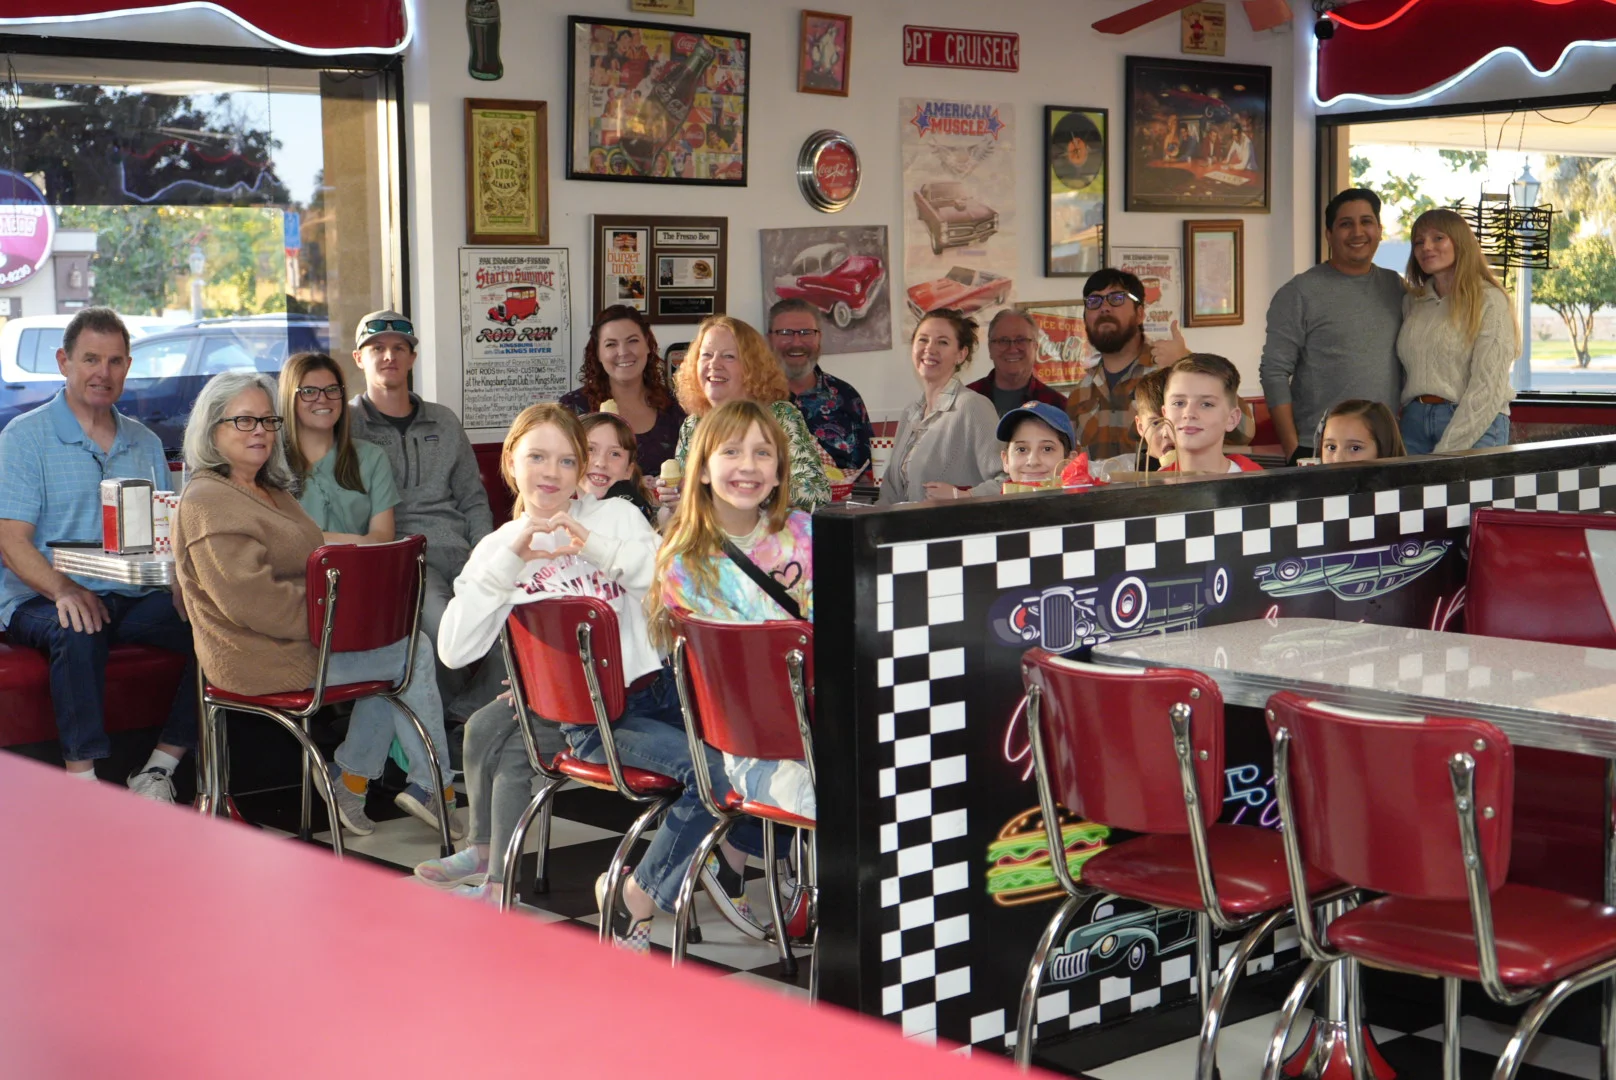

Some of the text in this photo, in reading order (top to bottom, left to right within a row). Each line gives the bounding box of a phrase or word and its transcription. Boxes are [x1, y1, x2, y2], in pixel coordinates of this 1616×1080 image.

[912, 32, 1012, 66] PT CRUISER
[924, 102, 992, 119] AMERICAN
[930, 117, 987, 136] MUSCLE
[494, 168, 515, 179] 1792
[490, 179, 518, 189] ALMANAC
[0, 217, 35, 234] ACOS
[663, 232, 675, 240] The
[676, 232, 697, 241] Fresno
[607, 248, 640, 265] burger
[611, 262, 636, 274] time
[515, 268, 555, 287] Summer
[1039, 320, 1056, 330] ICE
[476, 327, 558, 343] ROD RUN
